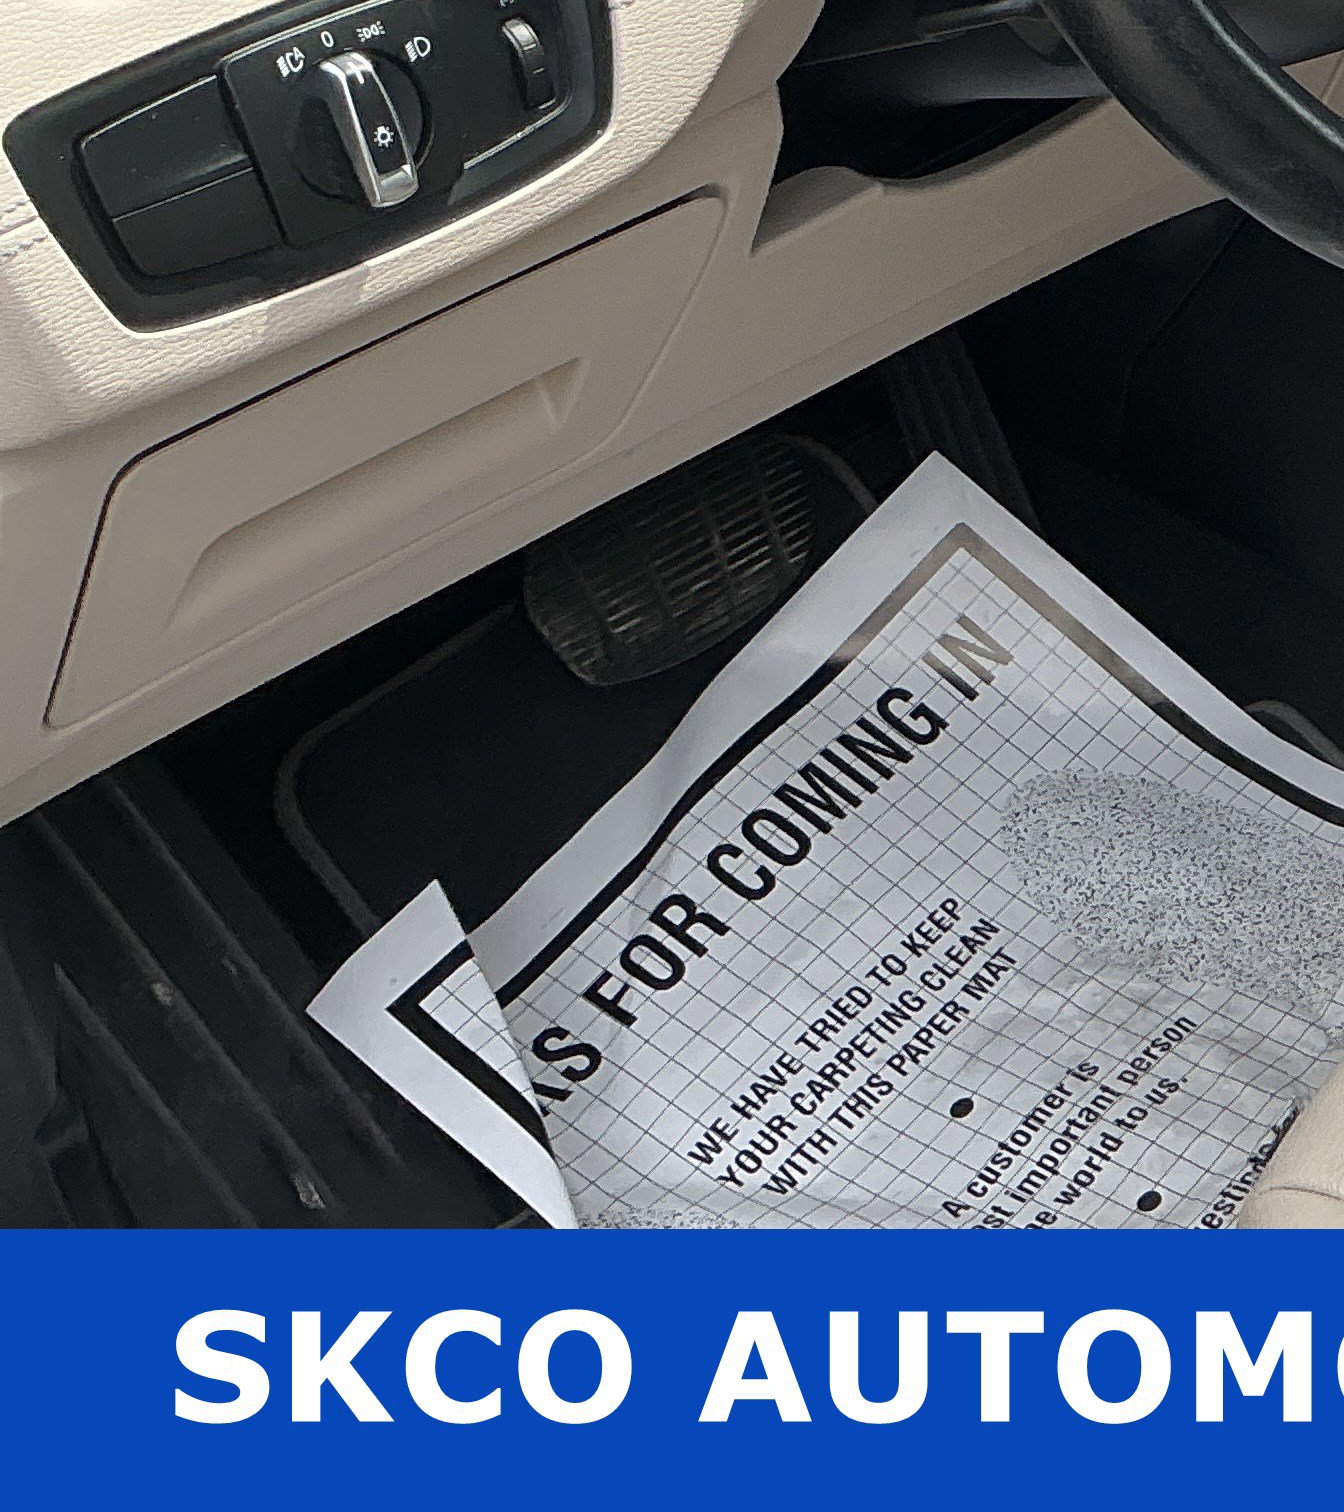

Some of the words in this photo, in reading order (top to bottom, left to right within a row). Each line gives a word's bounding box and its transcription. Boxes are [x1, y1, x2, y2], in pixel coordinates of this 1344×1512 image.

[320, 30, 334, 48] 0
[582, 892, 732, 1028] FOR
[706, 687, 950, 901] COMING
[922, 615, 1014, 702] IN
[687, 1117, 740, 1167] WE
[730, 1051, 805, 1120] HAVE
[795, 986, 874, 1053] TRIED
[865, 953, 908, 986] TO
[900, 897, 962, 958] KEEP
[716, 1114, 798, 1189] YOUR
[789, 989, 928, 1116] CARPETING
[919, 918, 1001, 992] CLEAN
[762, 1128, 838, 1196] WITH
[827, 1073, 894, 1130] THIS
[886, 1000, 971, 1078] PAPER
[960, 947, 1017, 1001] MAT
[941, 1199, 972, 1219] A
[967, 1081, 1074, 1199] customer
[1066, 1061, 1100, 1083] is
[1004, 1084, 1122, 1205] important
[1117, 1015, 1199, 1087] person
[1053, 1131, 1124, 1207] world
[1114, 1104, 1149, 1131] to
[1145, 1077, 1189, 1106] us.
